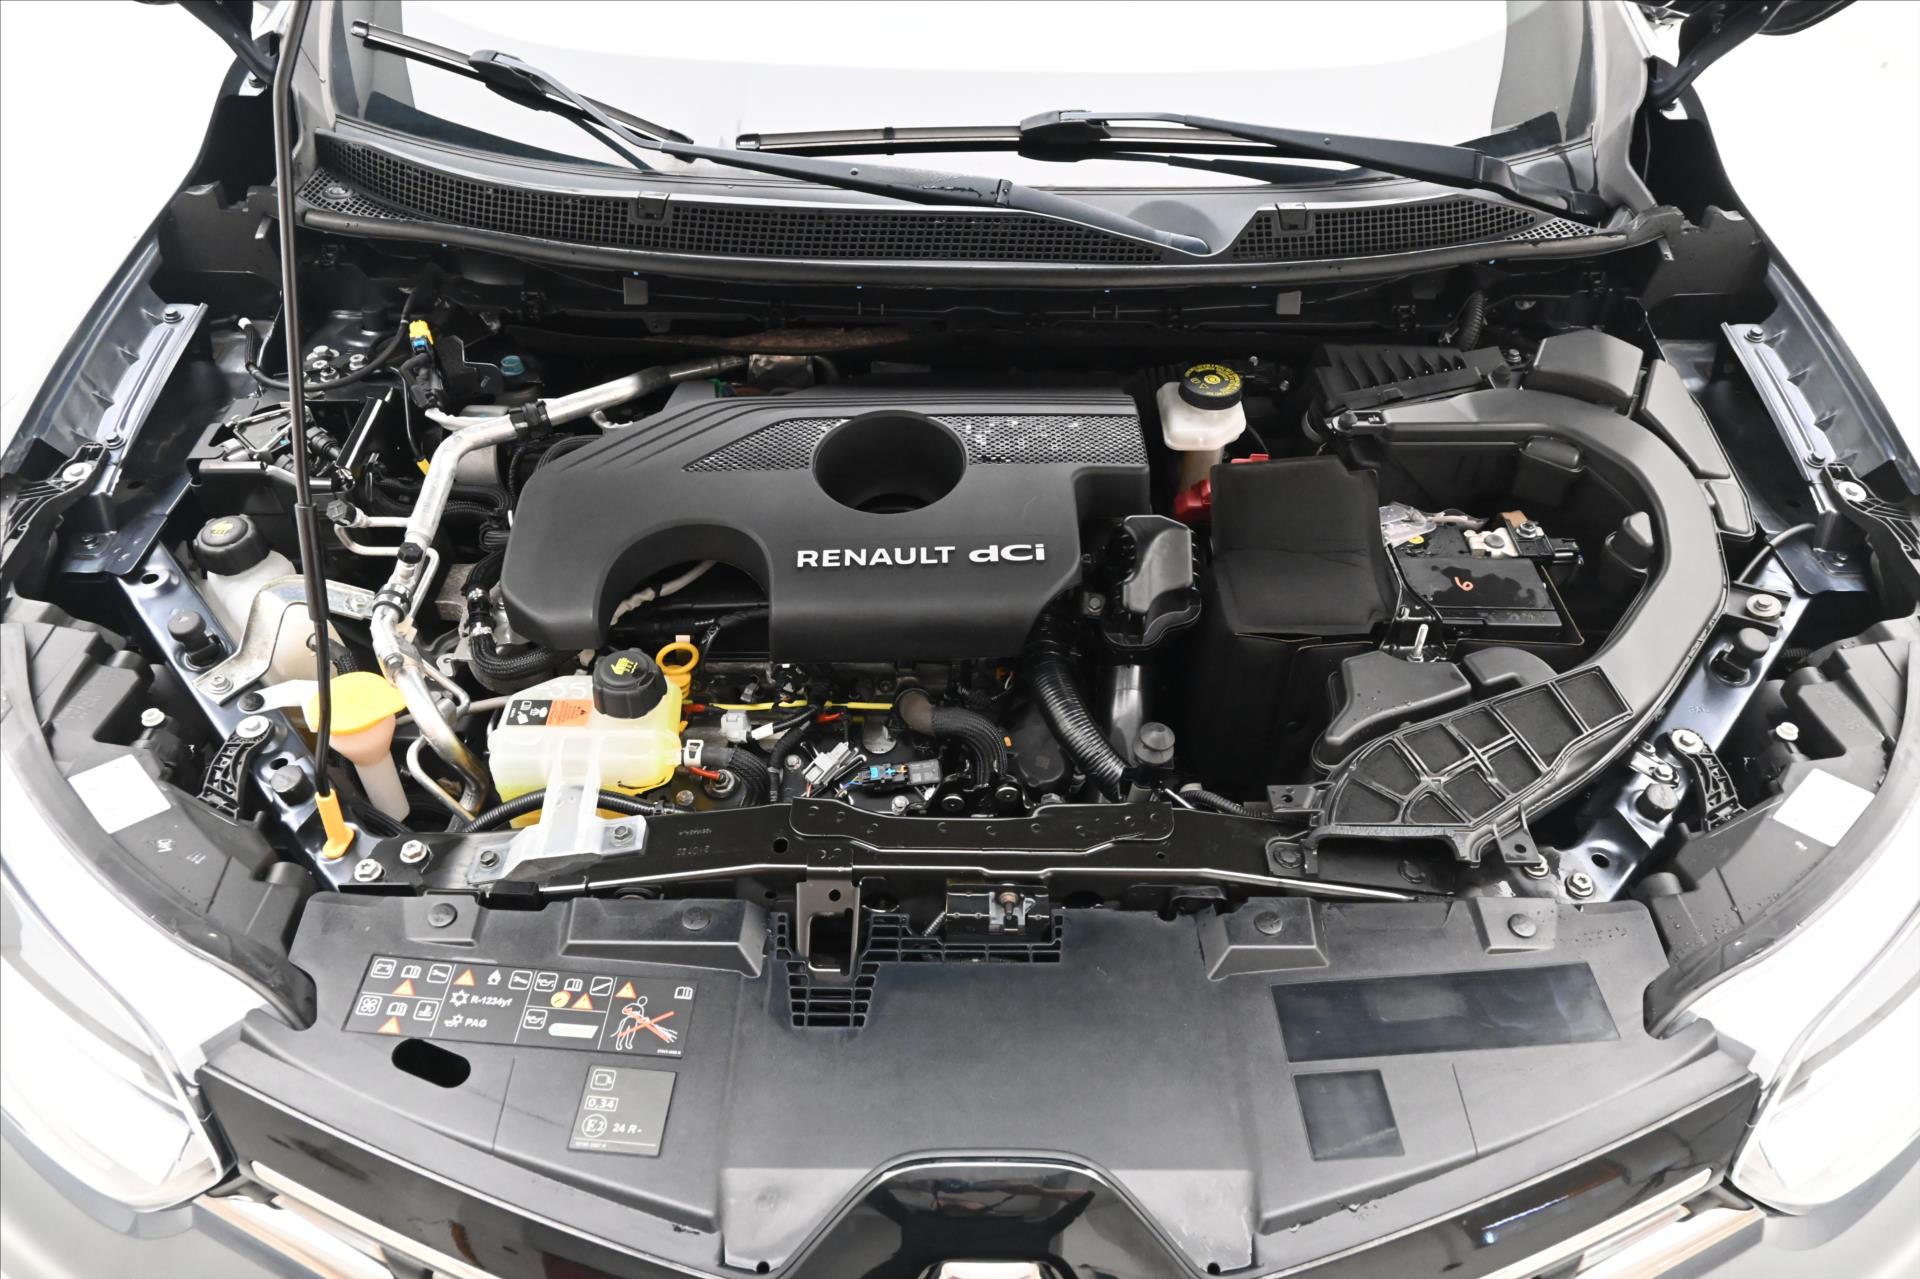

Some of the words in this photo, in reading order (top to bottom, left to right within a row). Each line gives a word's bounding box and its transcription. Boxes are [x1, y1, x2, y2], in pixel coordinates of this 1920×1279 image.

[796, 545, 956, 568] RENAULT
[968, 543, 1046, 563] dCi
[470, 994, 513, 1008] R-1234yf
[464, 1017, 488, 1028] PAG
[612, 1122, 625, 1133] 24
